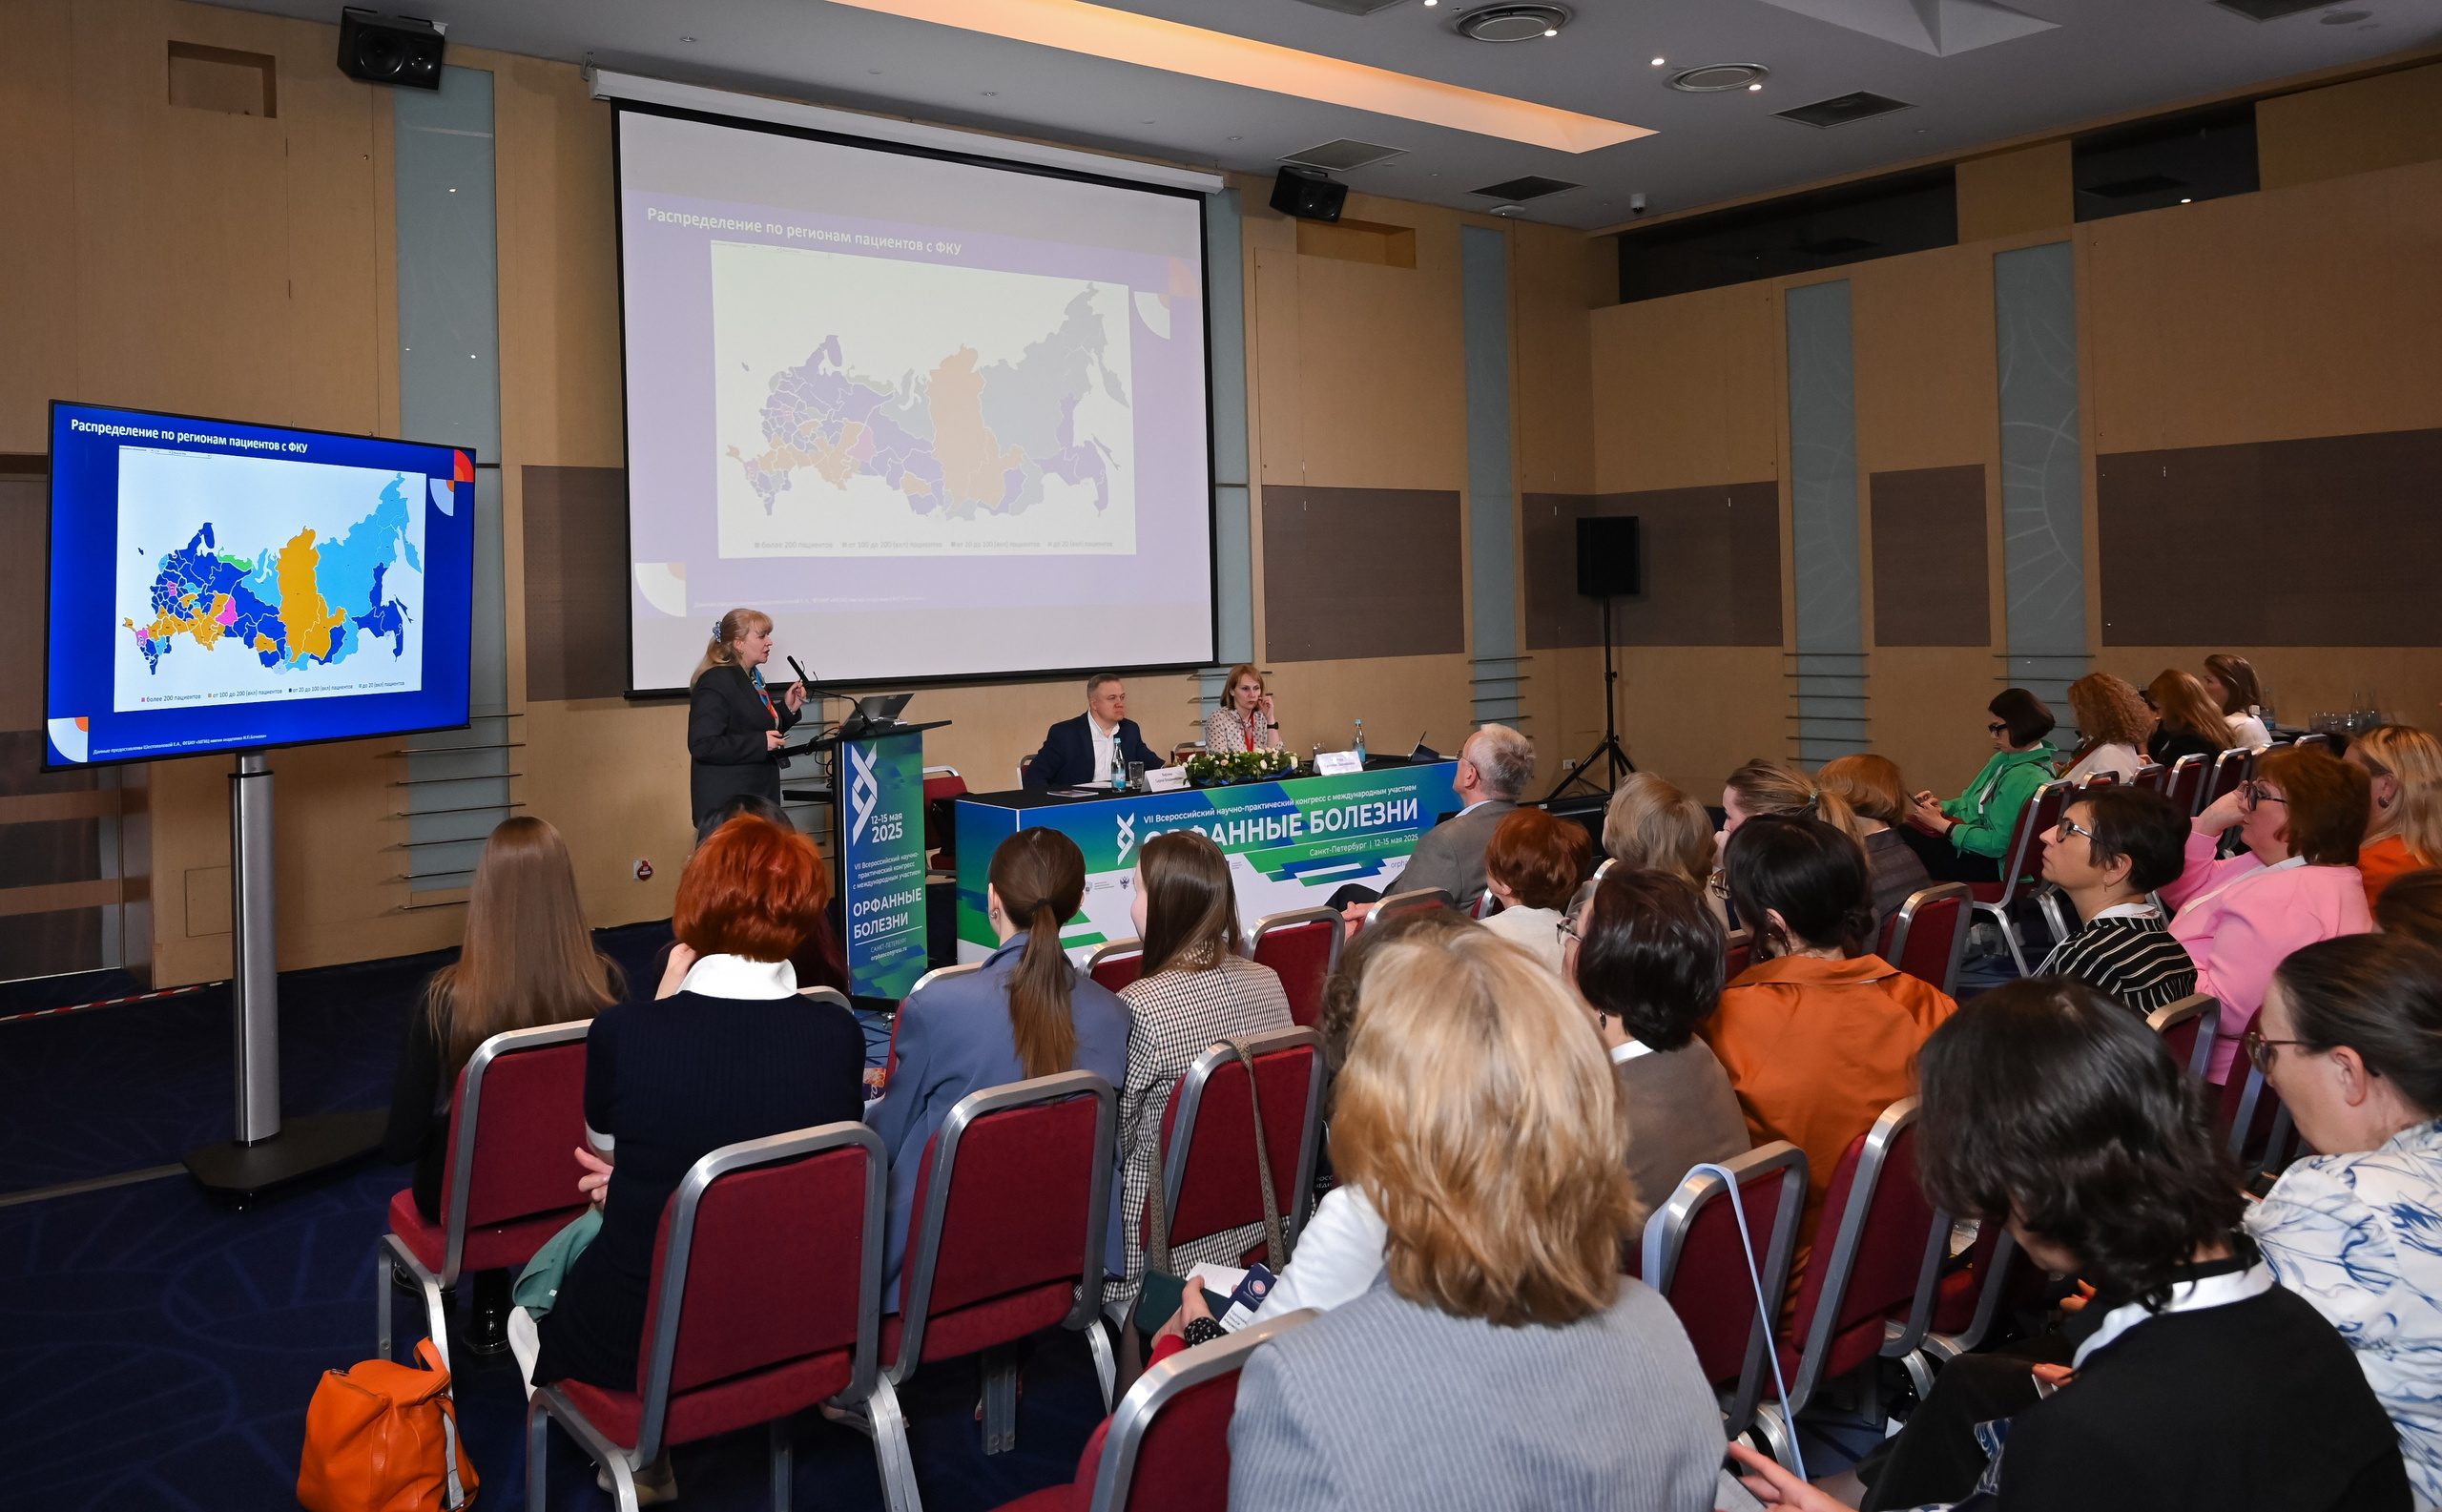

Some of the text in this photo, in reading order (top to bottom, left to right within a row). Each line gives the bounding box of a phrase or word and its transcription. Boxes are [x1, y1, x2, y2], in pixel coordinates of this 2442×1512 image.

[648, 207, 962, 256] Распределение по регионам пациентов с ФКУ
[71, 419, 308, 454] Распределение по регионам пациентов с ФКУ
[1143, 816, 1154, 824] VII
[1155, 807, 1215, 822] Всероссийский
[1216, 799, 1294, 818] научно-практический
[1294, 795, 1327, 806] конгресс
[1332, 788, 1387, 801] международным
[1387, 784, 1418, 796] участием
[889, 812, 903, 822] мая
[1144, 797, 1418, 846] АННЫЕ БОЛЕЗНИ
[871, 821, 903, 843] 2025
[1309, 841, 1368, 857] Санкт-Петербург
[1403, 834, 1418, 842] 2025
[858, 861, 916, 880] практический конгресс
[861, 855, 900, 869] Всероссийский
[900, 852, 919, 860] научно-
[857, 874, 899, 888] международным
[899, 869, 921, 880] участием
[852, 887, 922, 918] ОРФАННЫЕ
[854, 911, 909, 940] БОЛЕЗНИ
[870, 937, 908, 953] САНКТ-ПЕТЕРБУРГ
